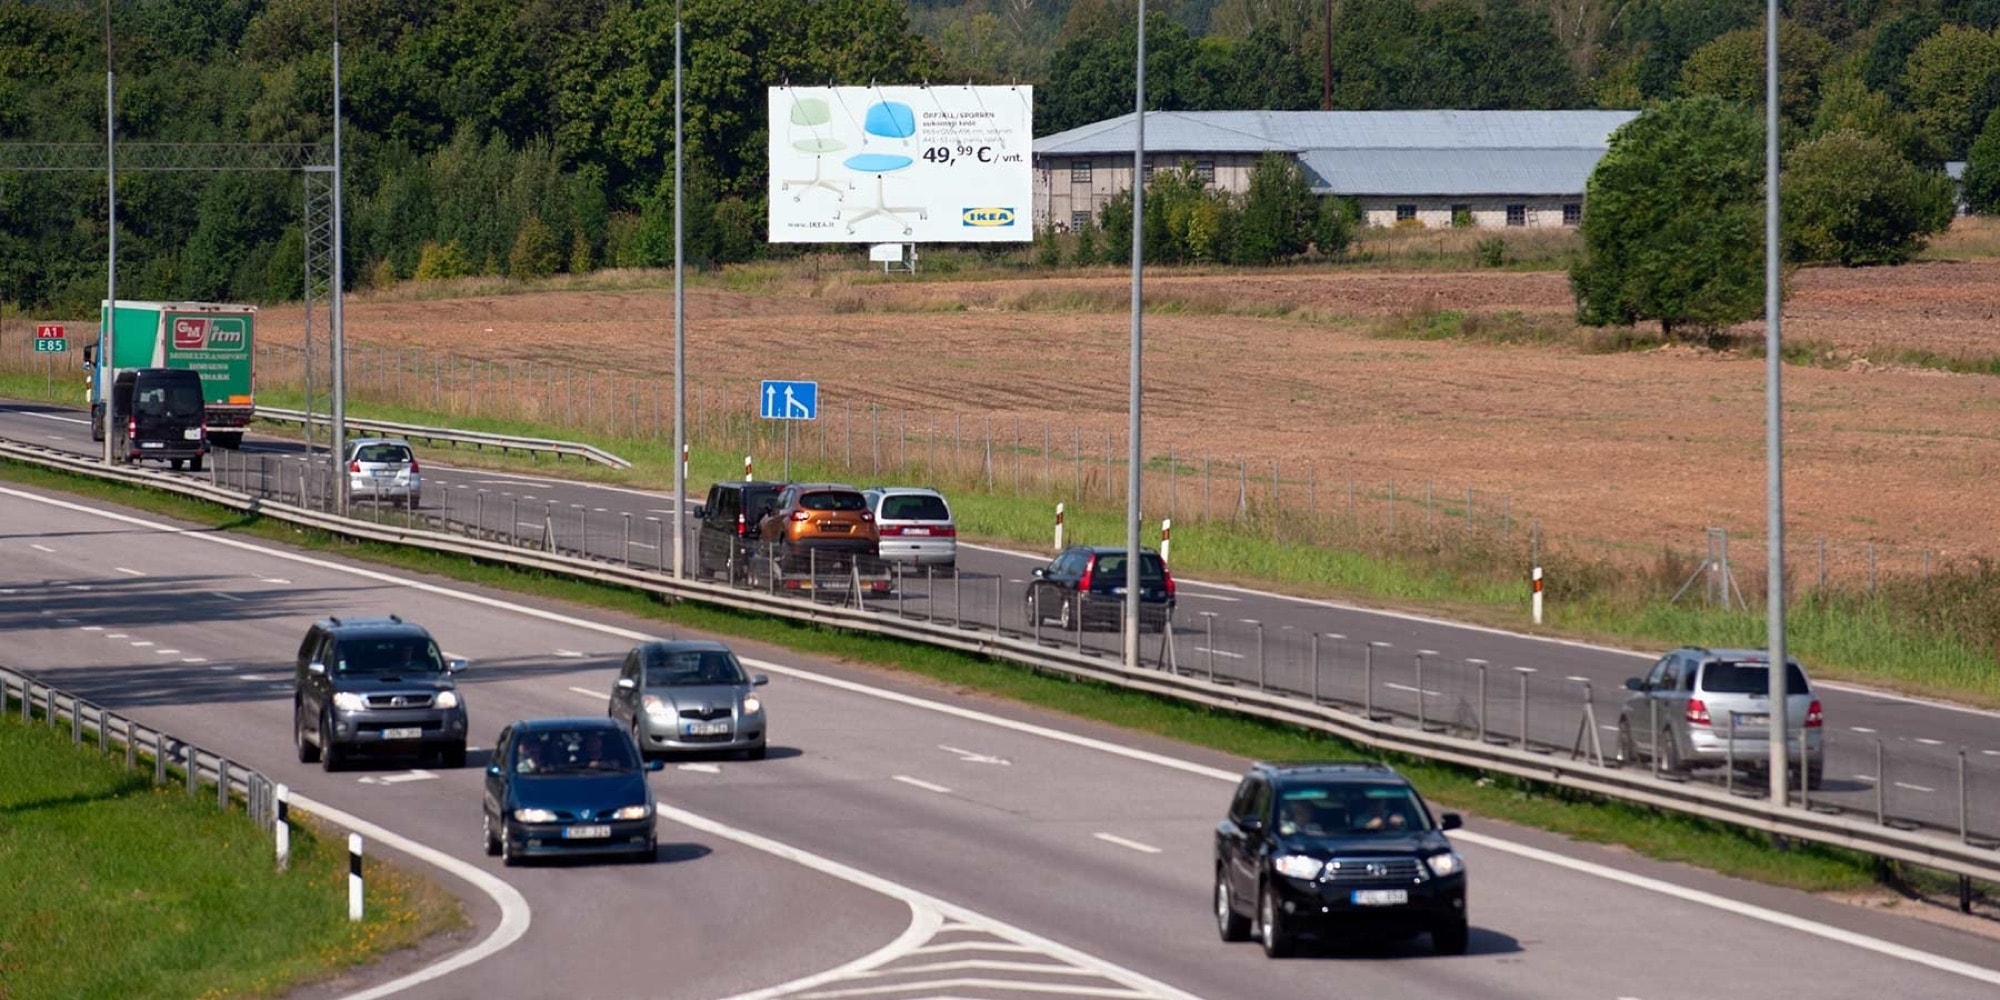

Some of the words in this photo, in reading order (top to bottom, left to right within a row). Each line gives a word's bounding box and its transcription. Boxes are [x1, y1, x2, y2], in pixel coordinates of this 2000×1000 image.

[970, 213, 1008, 221] IKEA
[43, 327, 57, 337] A1
[38, 340, 63, 351] E85
